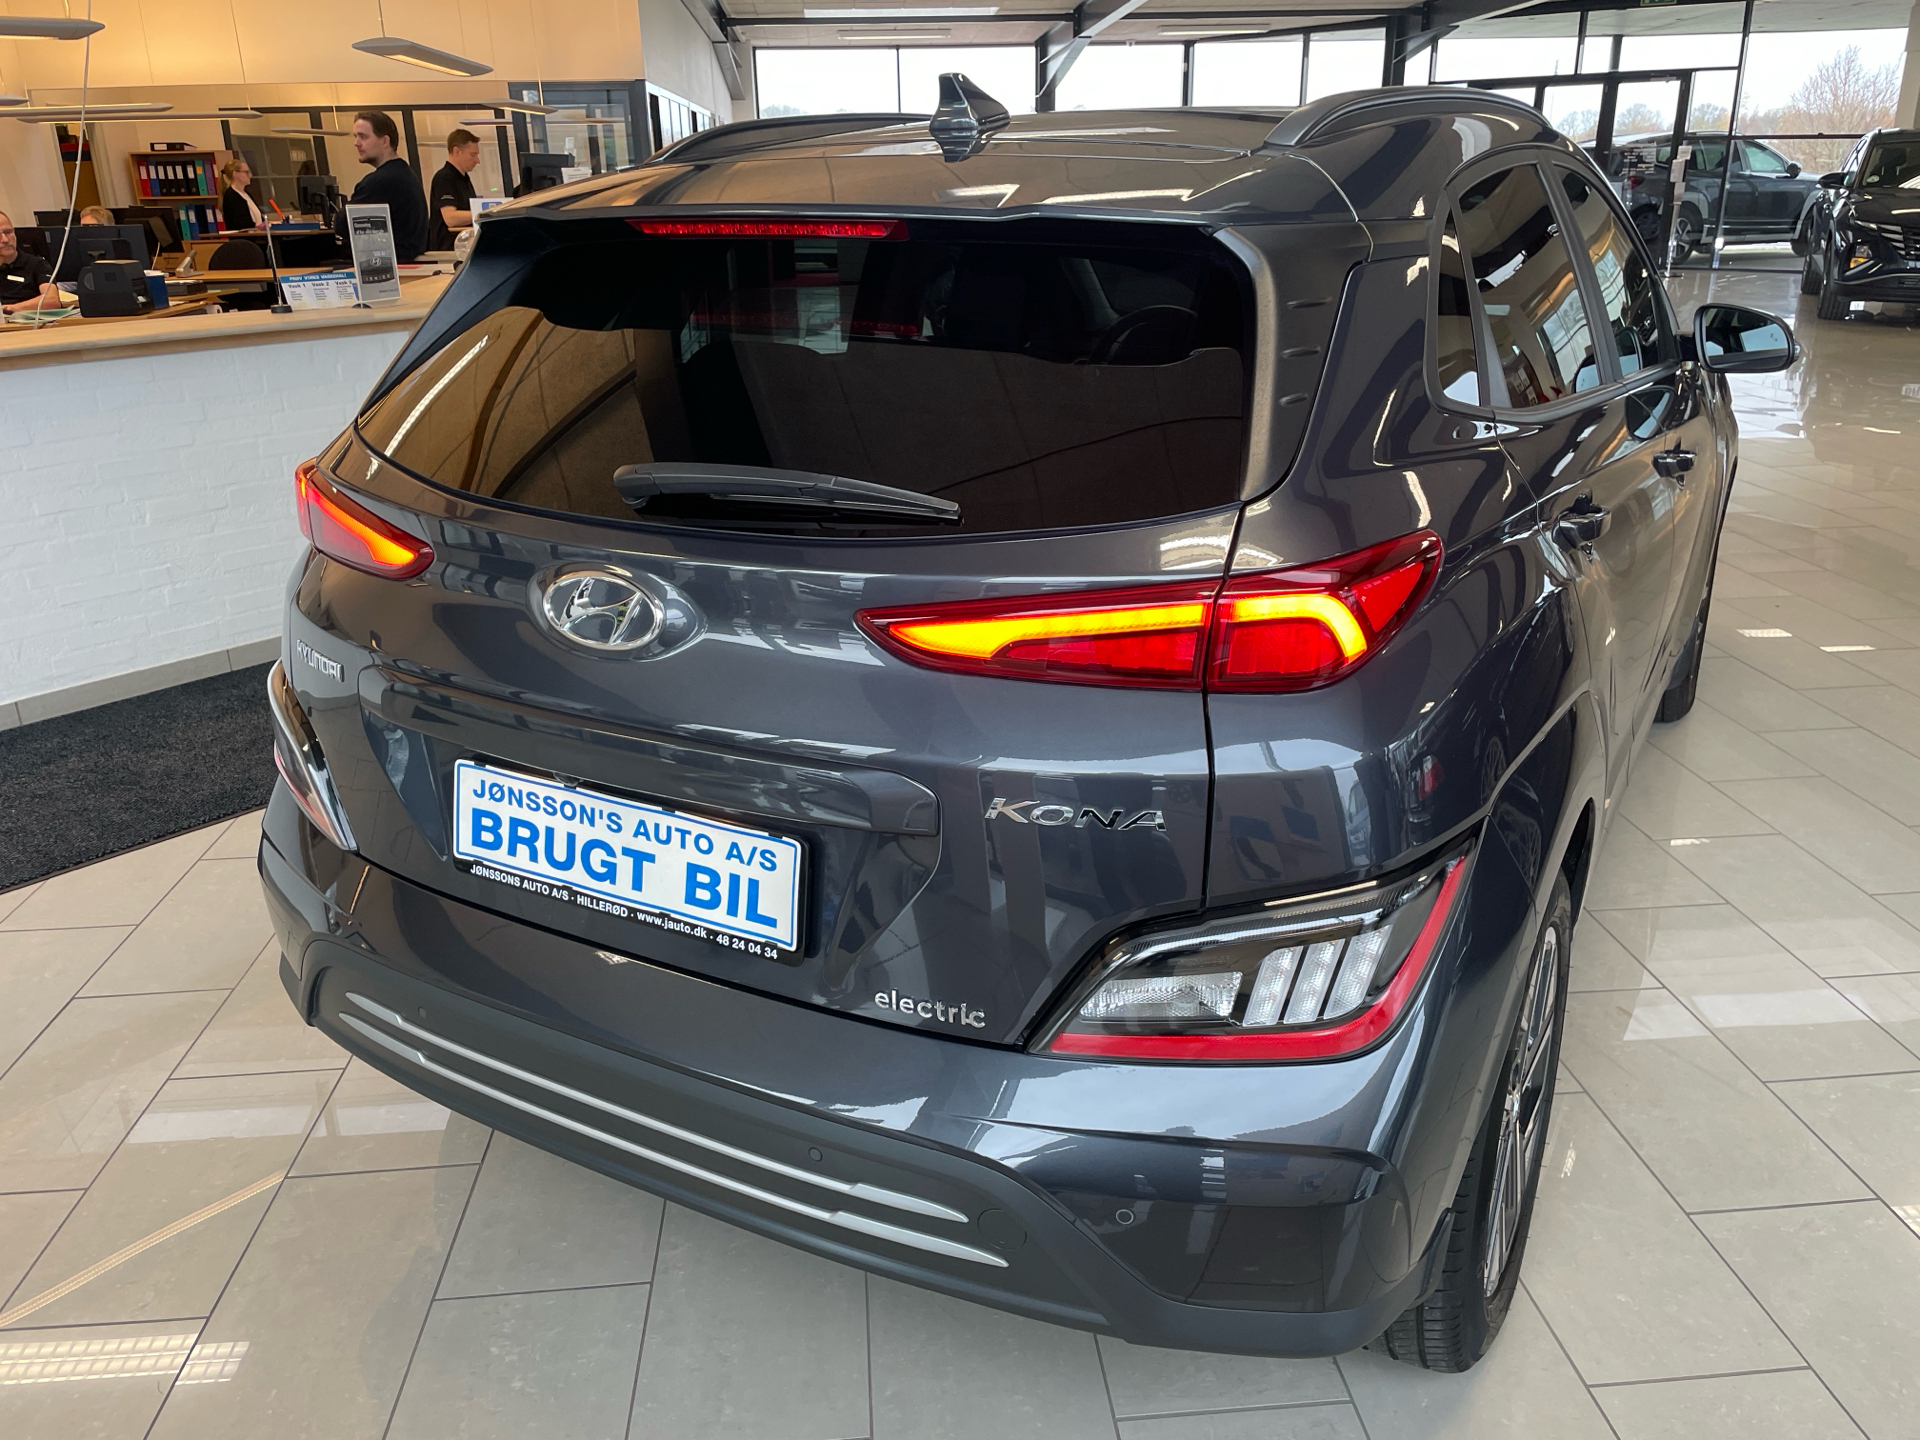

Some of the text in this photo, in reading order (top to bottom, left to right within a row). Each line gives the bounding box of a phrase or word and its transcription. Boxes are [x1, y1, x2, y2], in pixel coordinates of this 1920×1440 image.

[297, 640, 342, 682] HYUNDAI
[472, 779, 778, 872] JØNSSON'S AUTO A/S
[984, 797, 1167, 832] KONA
[471, 808, 778, 929] BRUGT BIL
[470, 864, 777, 959] JØNSSONS AUTO A/S HILLERØD www.jauto.dk 48 24 04 34
[874, 988, 986, 1028] electric
